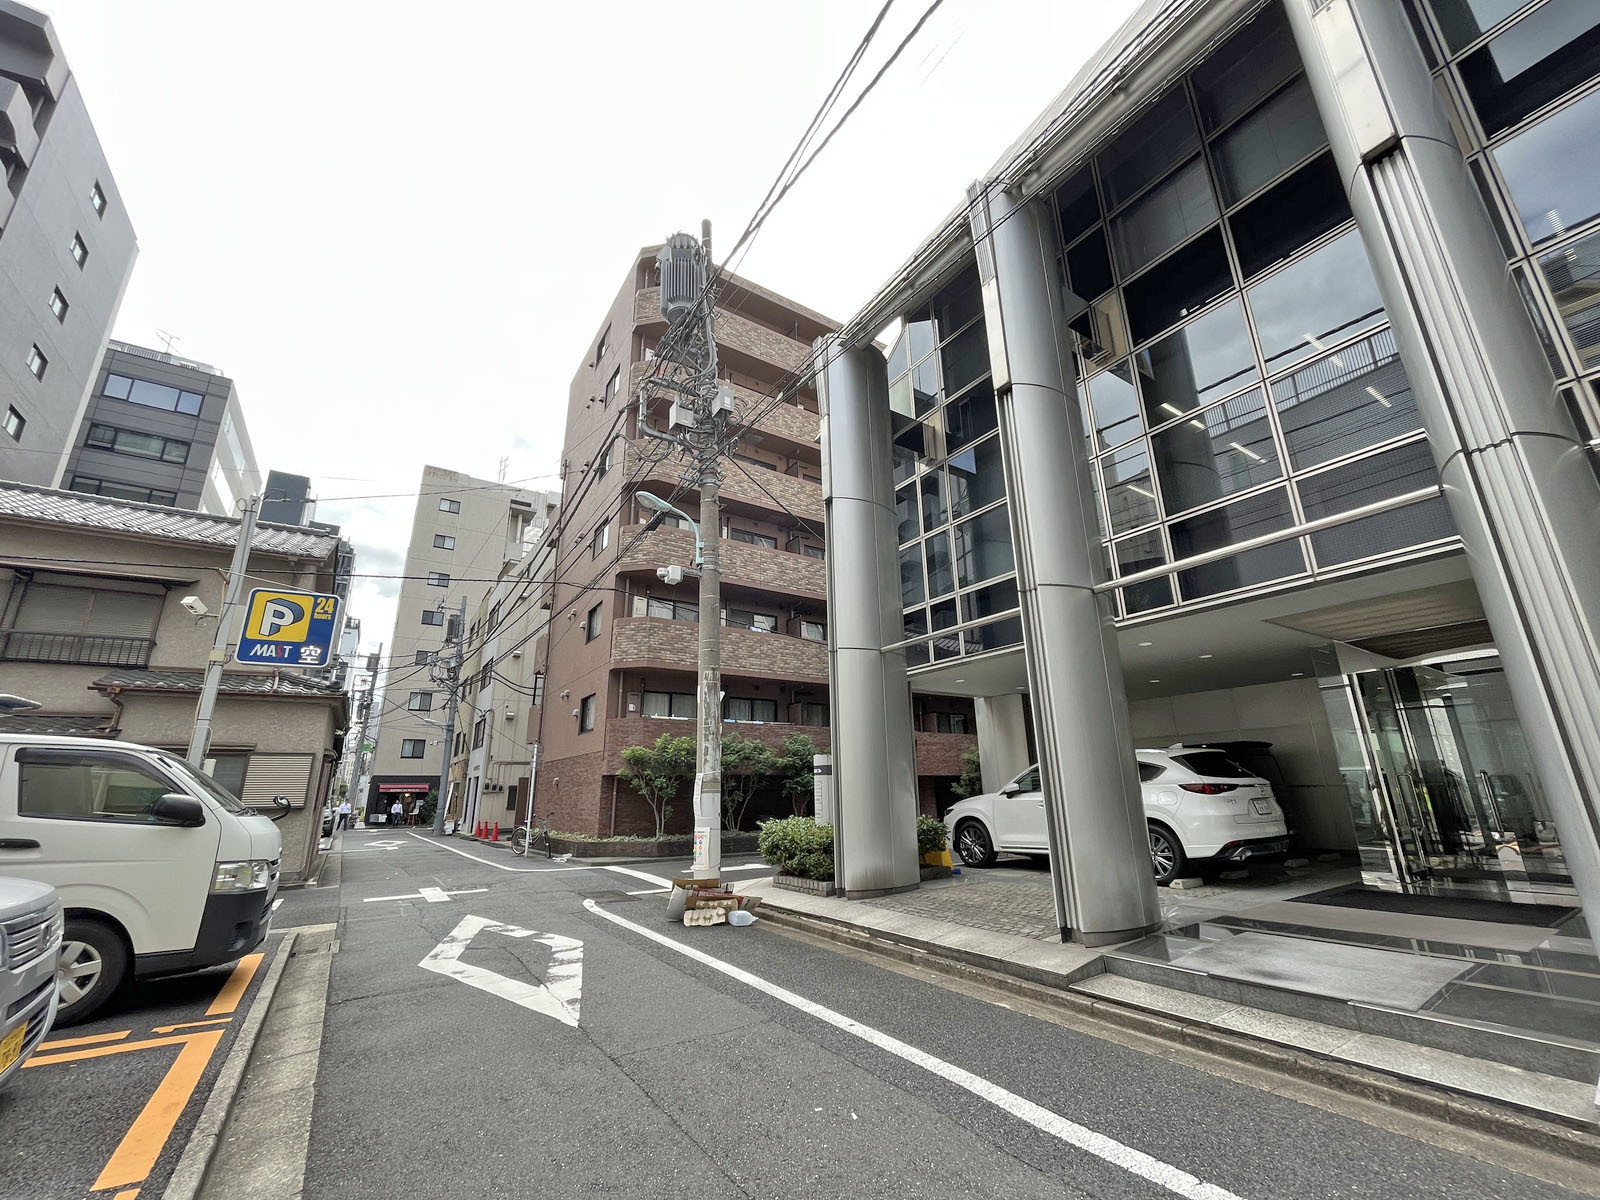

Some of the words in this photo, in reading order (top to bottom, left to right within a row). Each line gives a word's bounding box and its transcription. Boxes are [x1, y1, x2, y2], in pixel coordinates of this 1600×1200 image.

[315, 597, 335, 614] 24
[259, 598, 304, 637] P
[249, 643, 293, 658] MAST
[298, 645, 321, 664] 空
